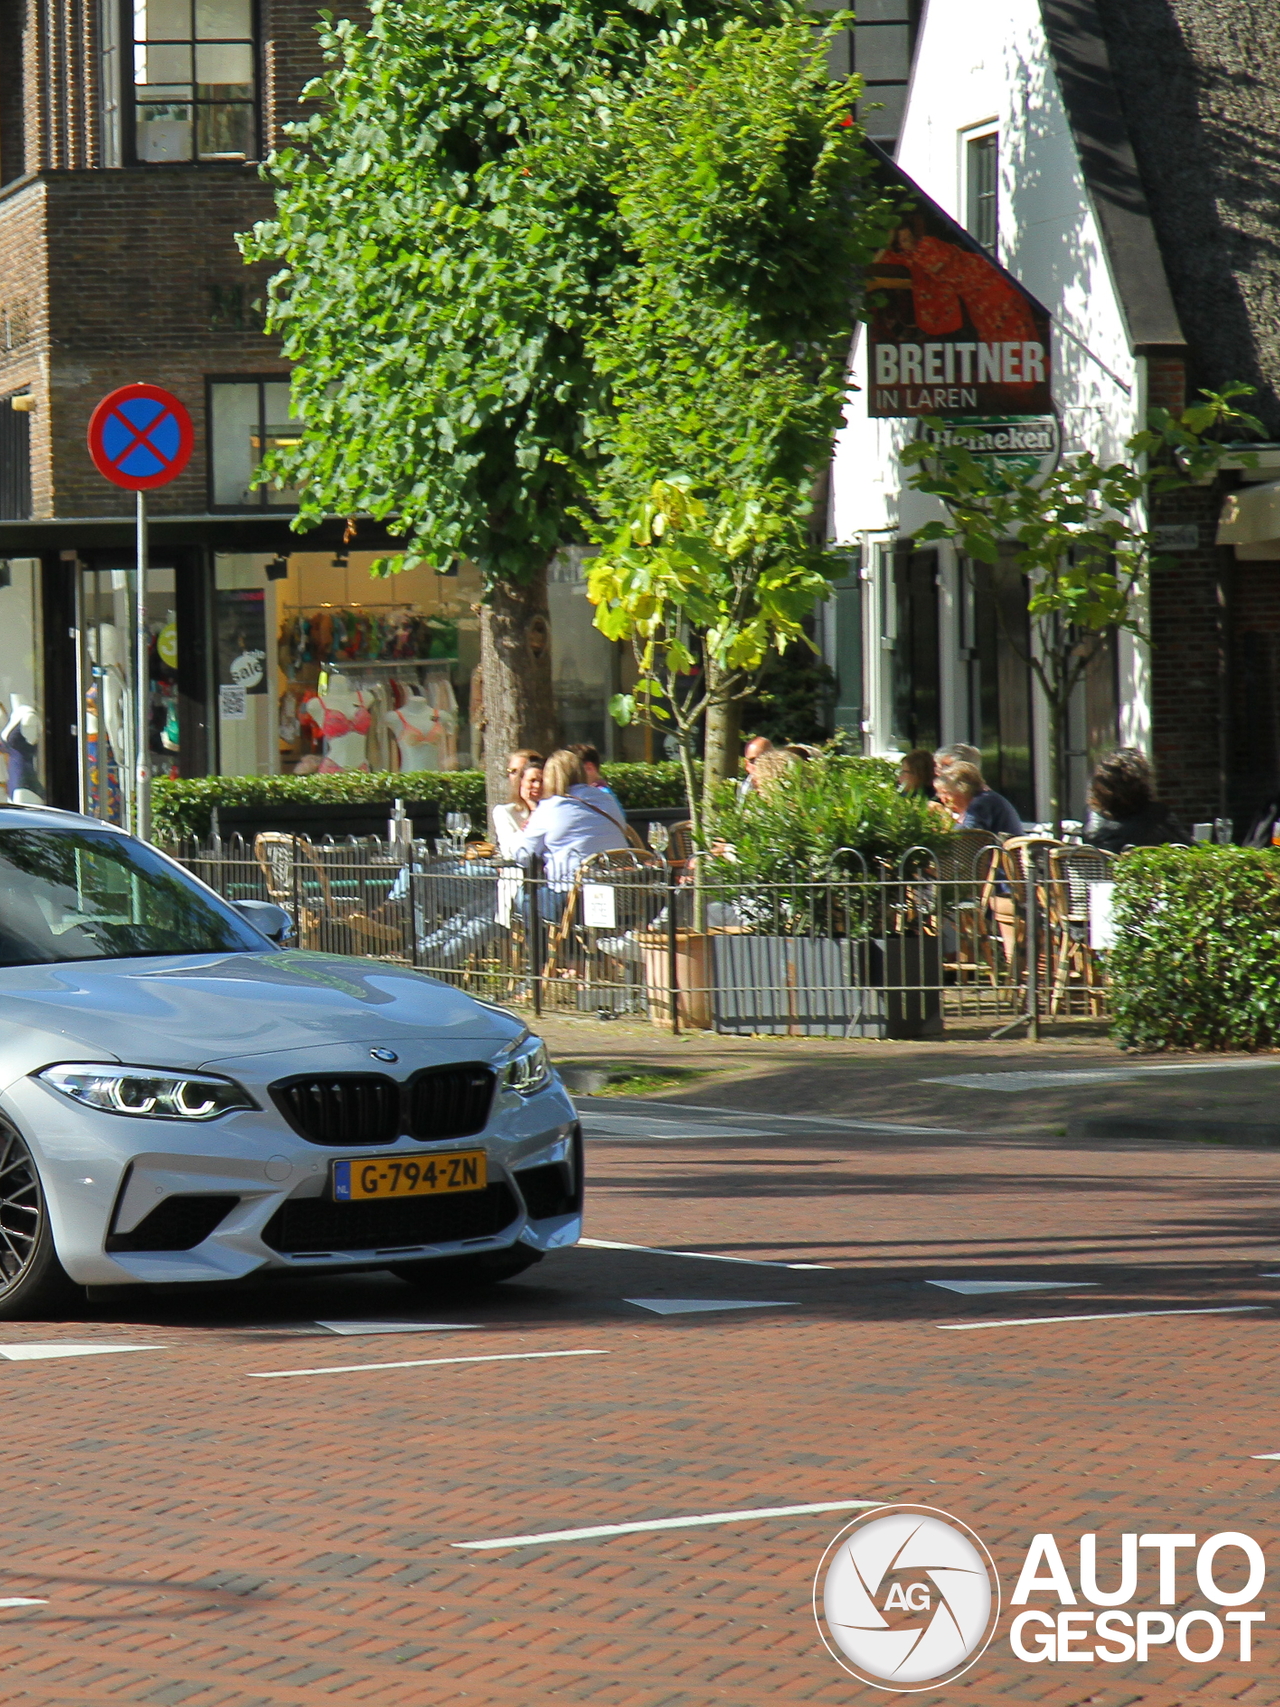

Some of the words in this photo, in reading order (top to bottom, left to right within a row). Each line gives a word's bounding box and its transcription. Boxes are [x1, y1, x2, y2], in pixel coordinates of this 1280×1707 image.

[875, 341, 1046, 385] BREITNER
[876, 389, 899, 409] IN
[906, 388, 978, 409] LAREN
[231, 661, 263, 682] sale
[361, 1157, 477, 1193] G-794-ZN
[336, 1185, 349, 1194] NL
